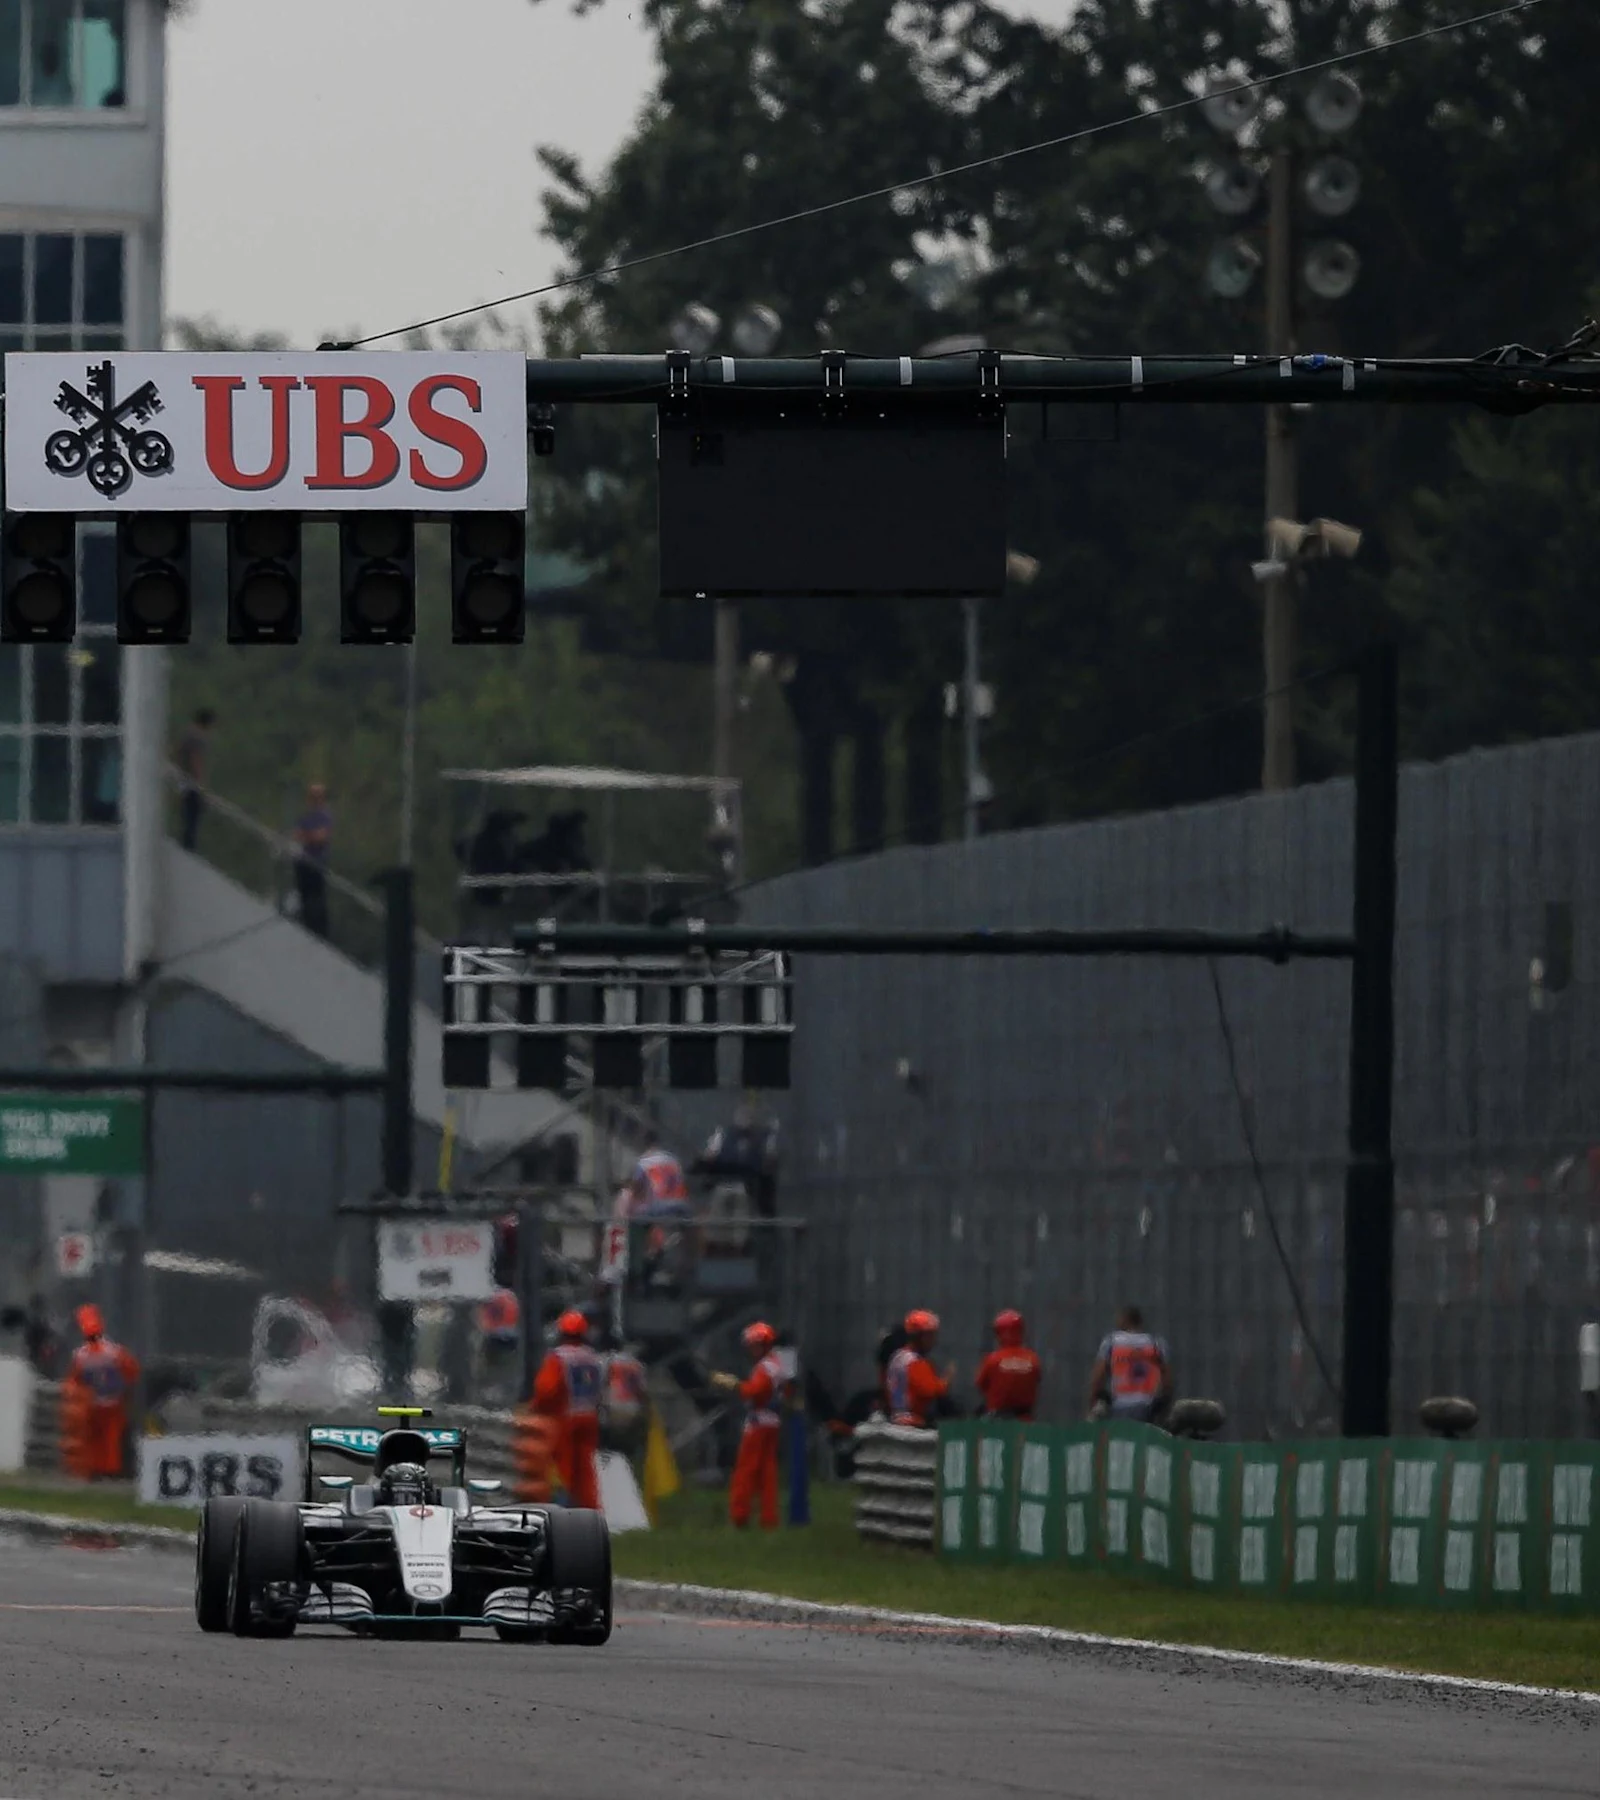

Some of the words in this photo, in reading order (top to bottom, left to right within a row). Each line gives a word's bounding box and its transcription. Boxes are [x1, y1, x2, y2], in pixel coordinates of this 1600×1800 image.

[192, 374, 487, 490] UBS
[311, 1427, 456, 1447] PETRAS
[159, 1452, 284, 1499] DRS
